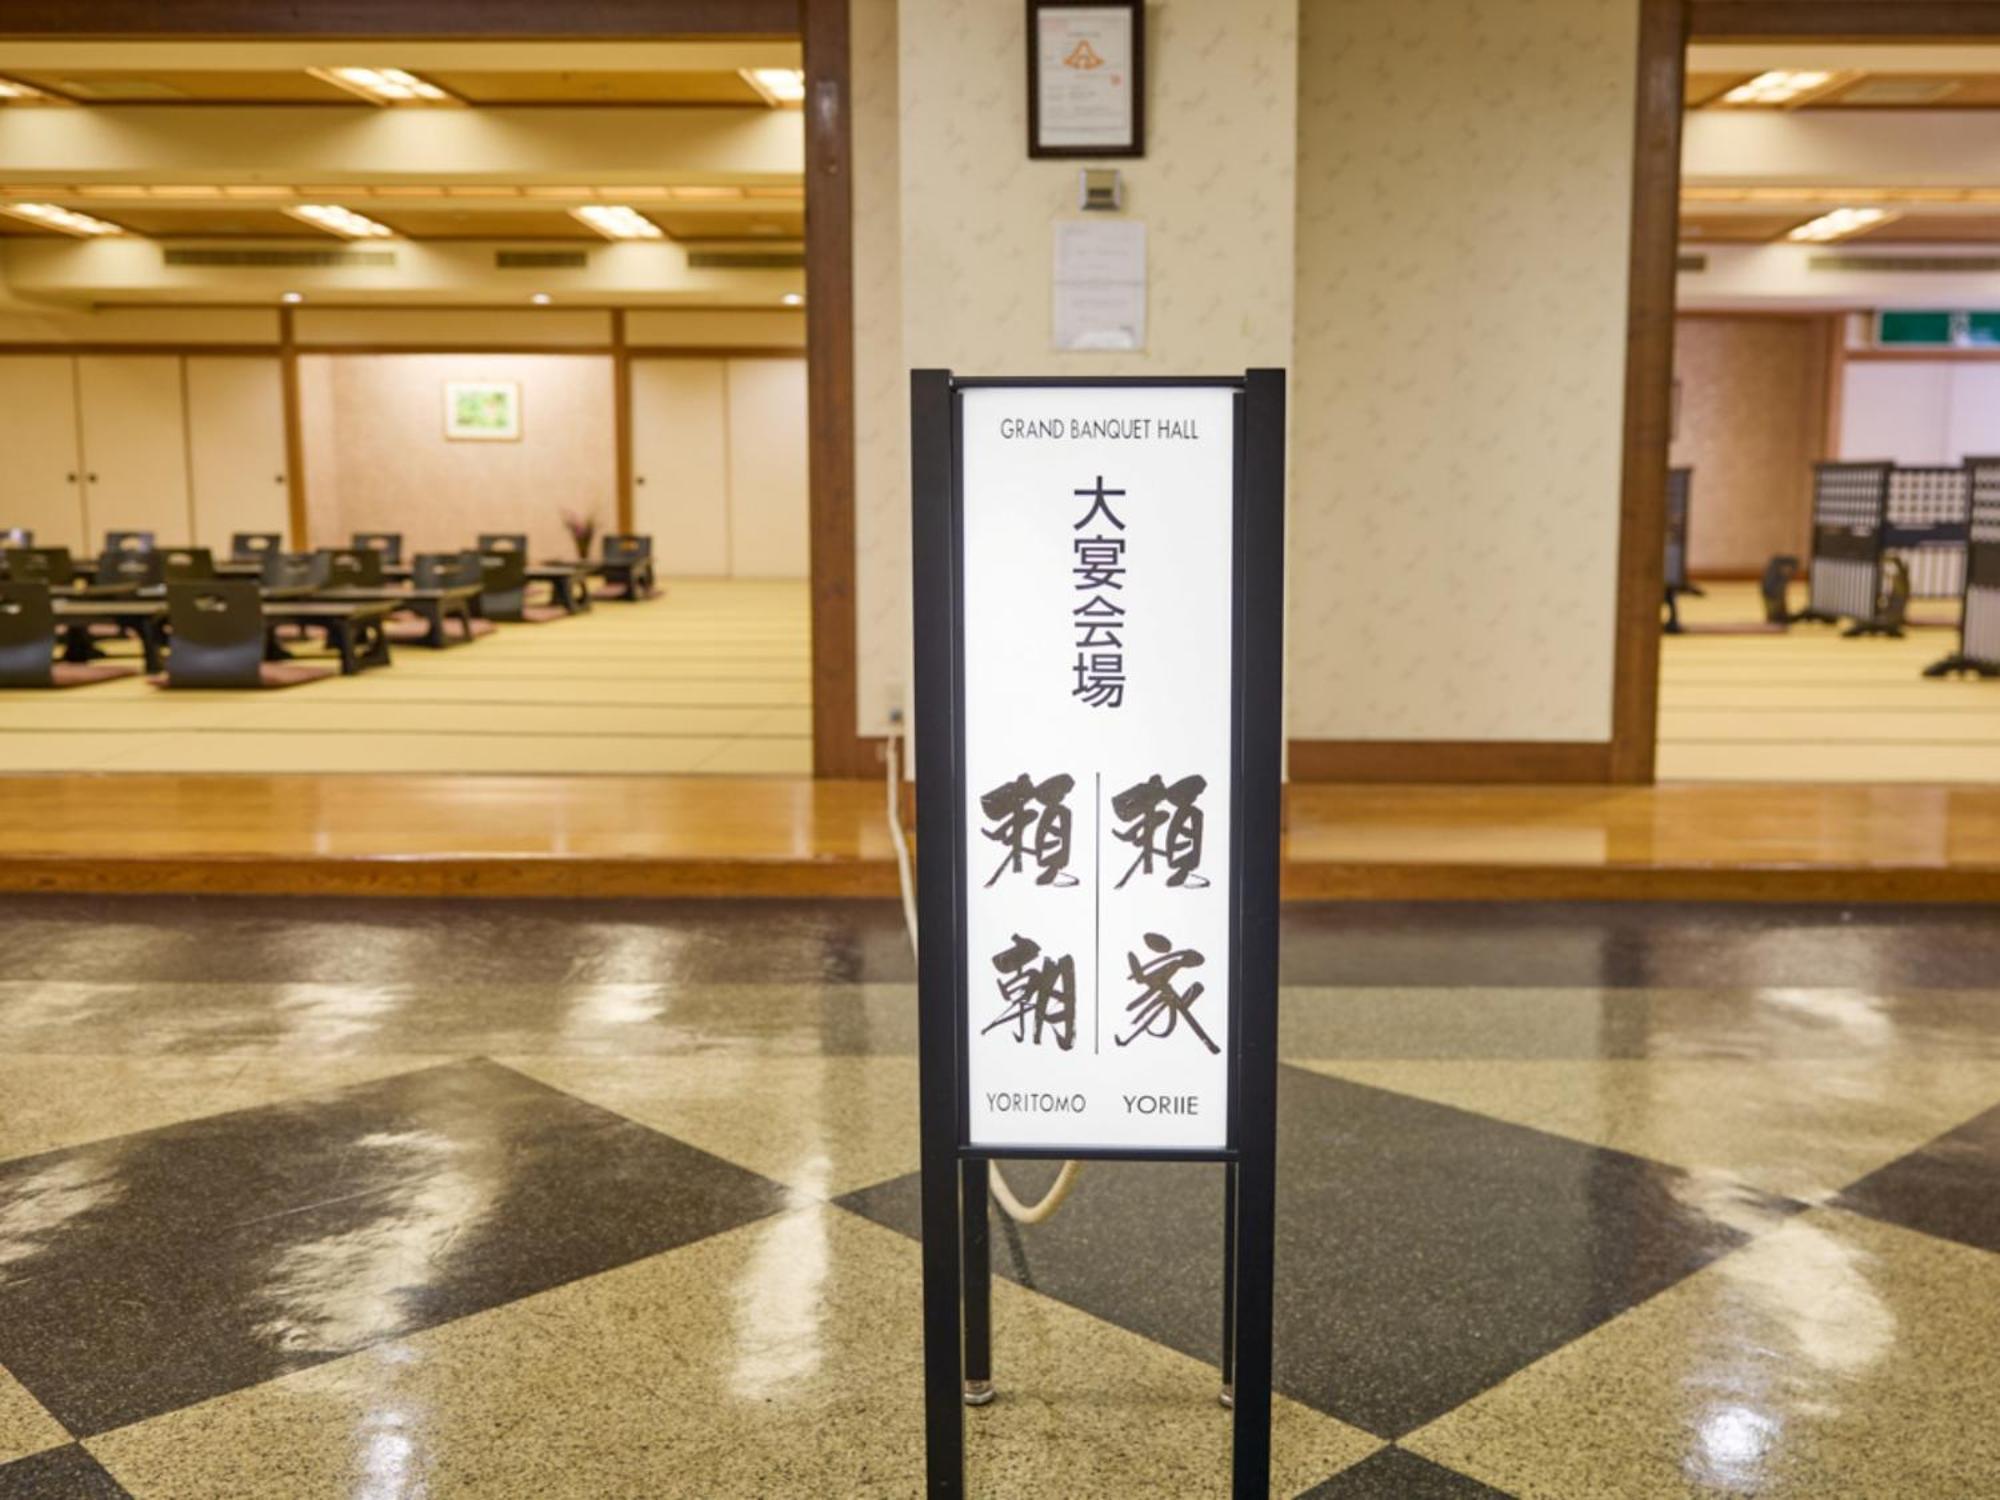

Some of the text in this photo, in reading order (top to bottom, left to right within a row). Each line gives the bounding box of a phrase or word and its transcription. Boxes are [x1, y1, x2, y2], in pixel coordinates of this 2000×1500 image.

[1000, 418, 1199, 441] GRAND BANQUET HALL
[1072, 475, 1126, 708] 大宴会場
[986, 1092, 1199, 1115] YORITOMO YORIIE
